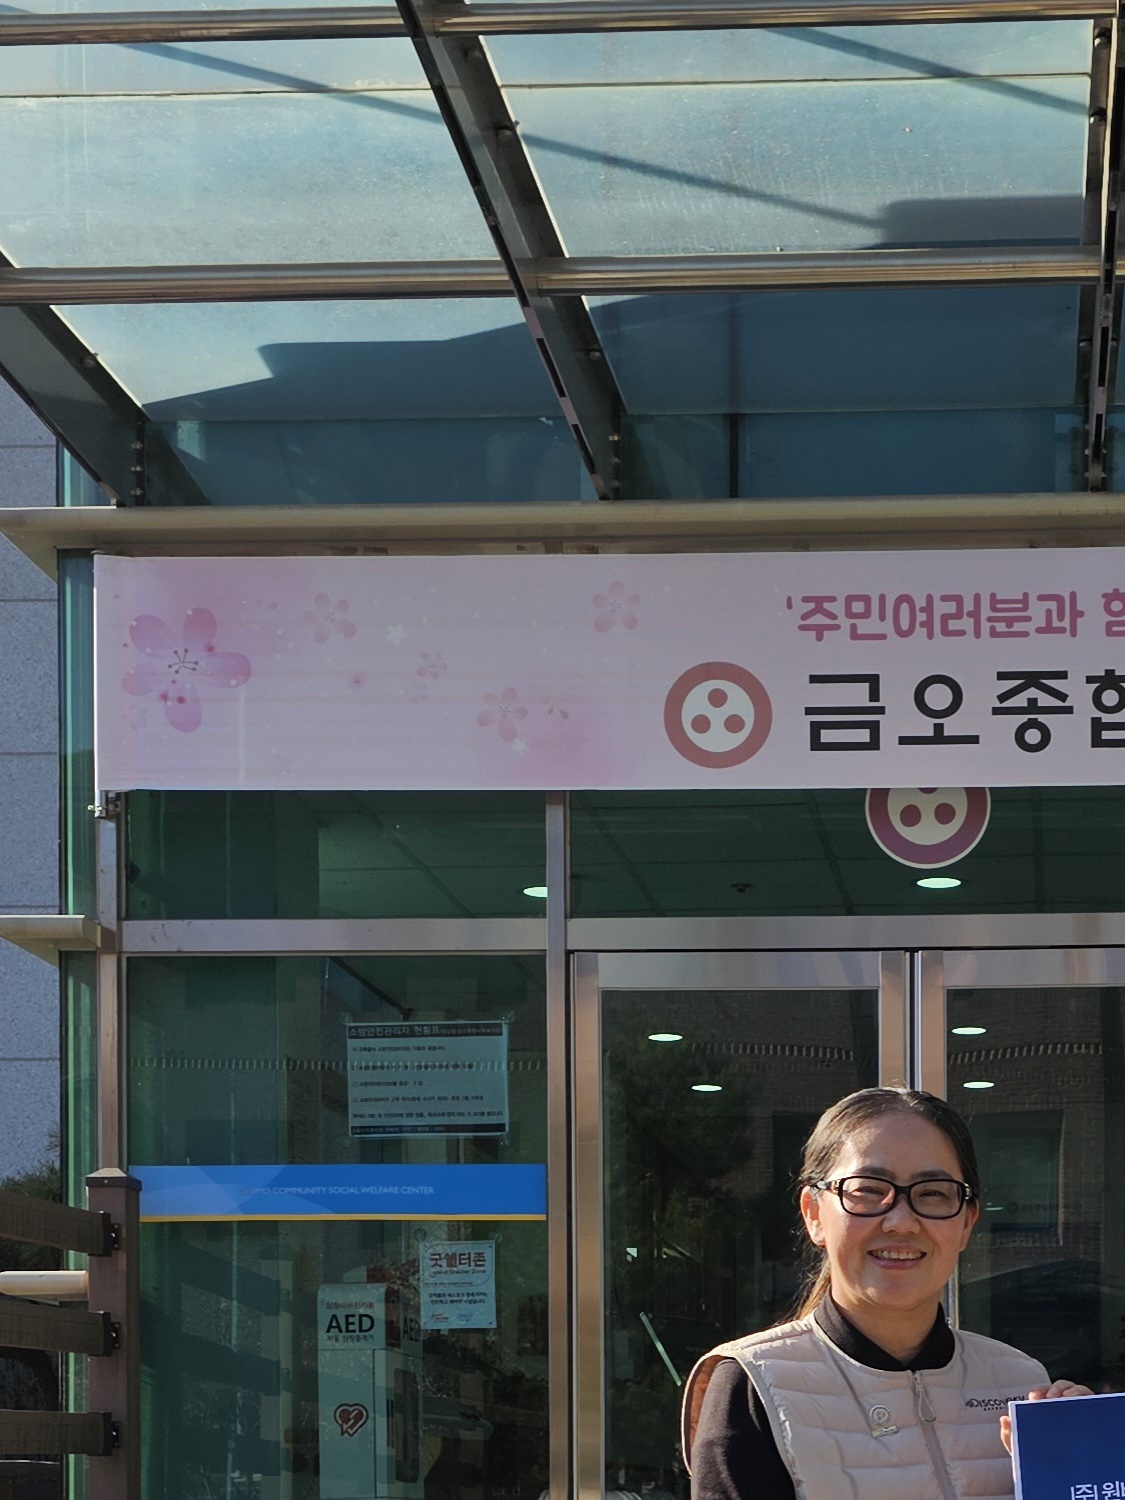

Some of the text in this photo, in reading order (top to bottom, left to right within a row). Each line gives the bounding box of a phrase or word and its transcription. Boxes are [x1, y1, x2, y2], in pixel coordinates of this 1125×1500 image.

[272, 1186, 327, 1195] COMMUNITY
[328, 1186, 359, 1195] SOCIAL
[361, 1186, 399, 1194] WELFARE
[401, 1186, 435, 1195] CENTER
[429, 1252, 486, 1268] 굿쉘터존
[326, 1313, 375, 1334] AED
